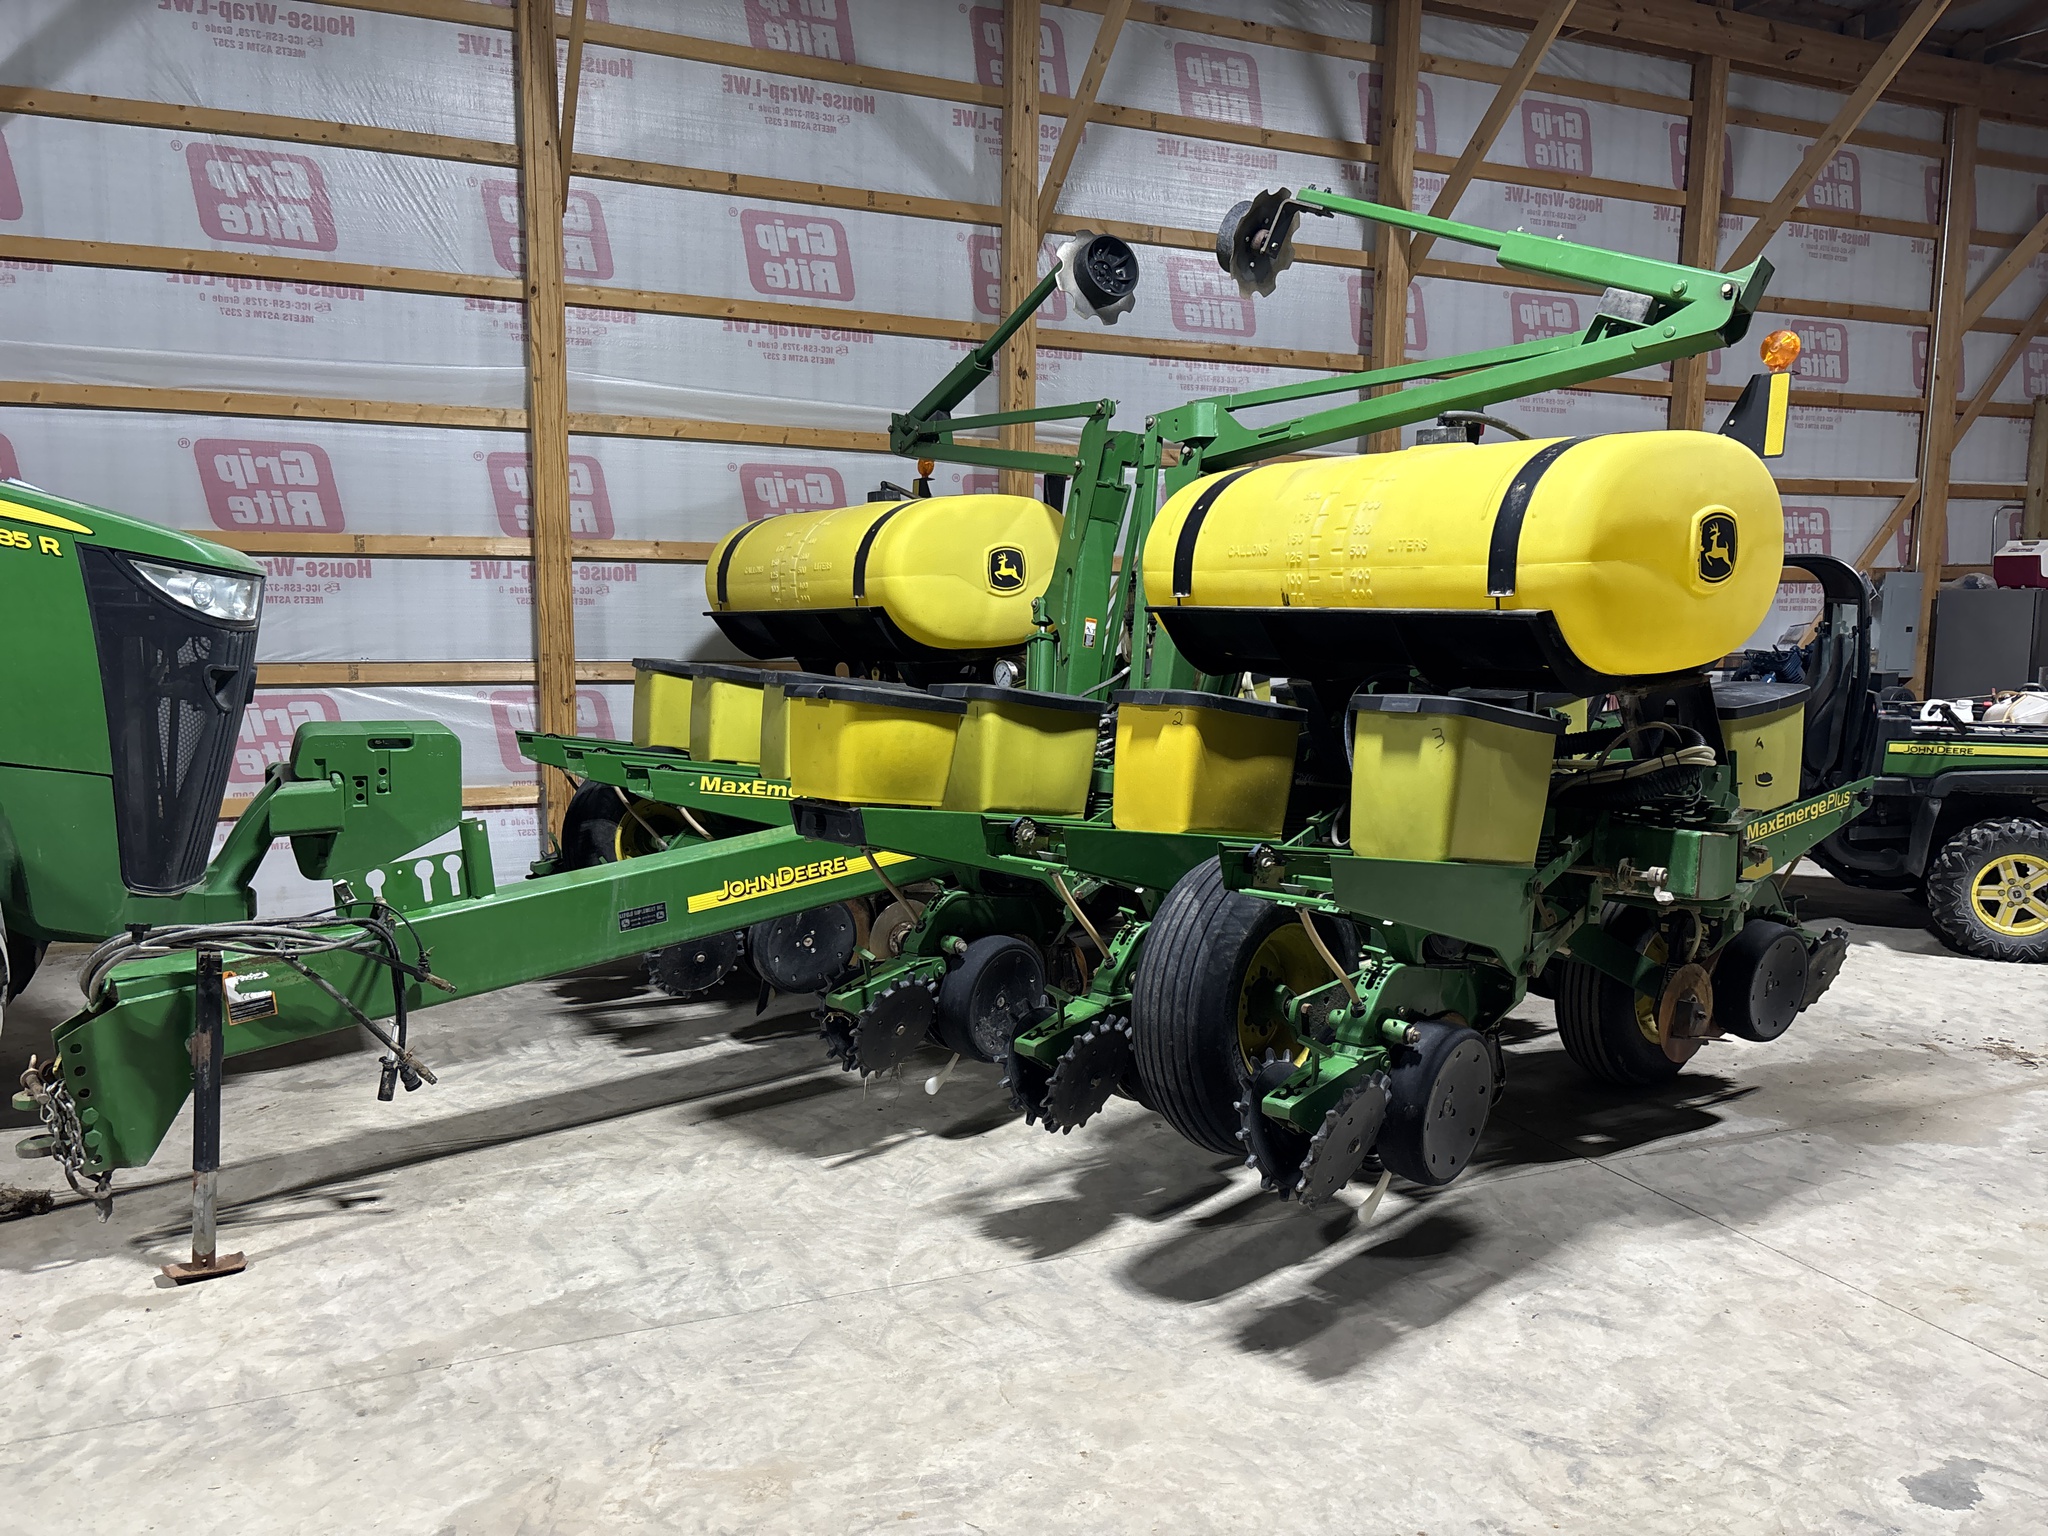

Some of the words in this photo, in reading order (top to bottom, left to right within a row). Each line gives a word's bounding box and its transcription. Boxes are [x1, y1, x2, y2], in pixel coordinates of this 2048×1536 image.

[38, 535, 62, 557] R
[1228, 543, 1269, 559] GALLONS
[1350, 545, 1368, 557] 500
[1388, 538, 1428, 552] LITERS
[1285, 552, 1302, 564] 125
[1286, 574, 1303, 585] 100
[1350, 568, 1371, 580] 400
[1171, 711, 1184, 726] 2
[1431, 728, 1446, 750] 3
[1903, 744, 1935, 755] JOHN
[1936, 745, 1975, 755] DEERE
[717, 872, 776, 901] JOHN
[777, 856, 848, 886] DEERE
